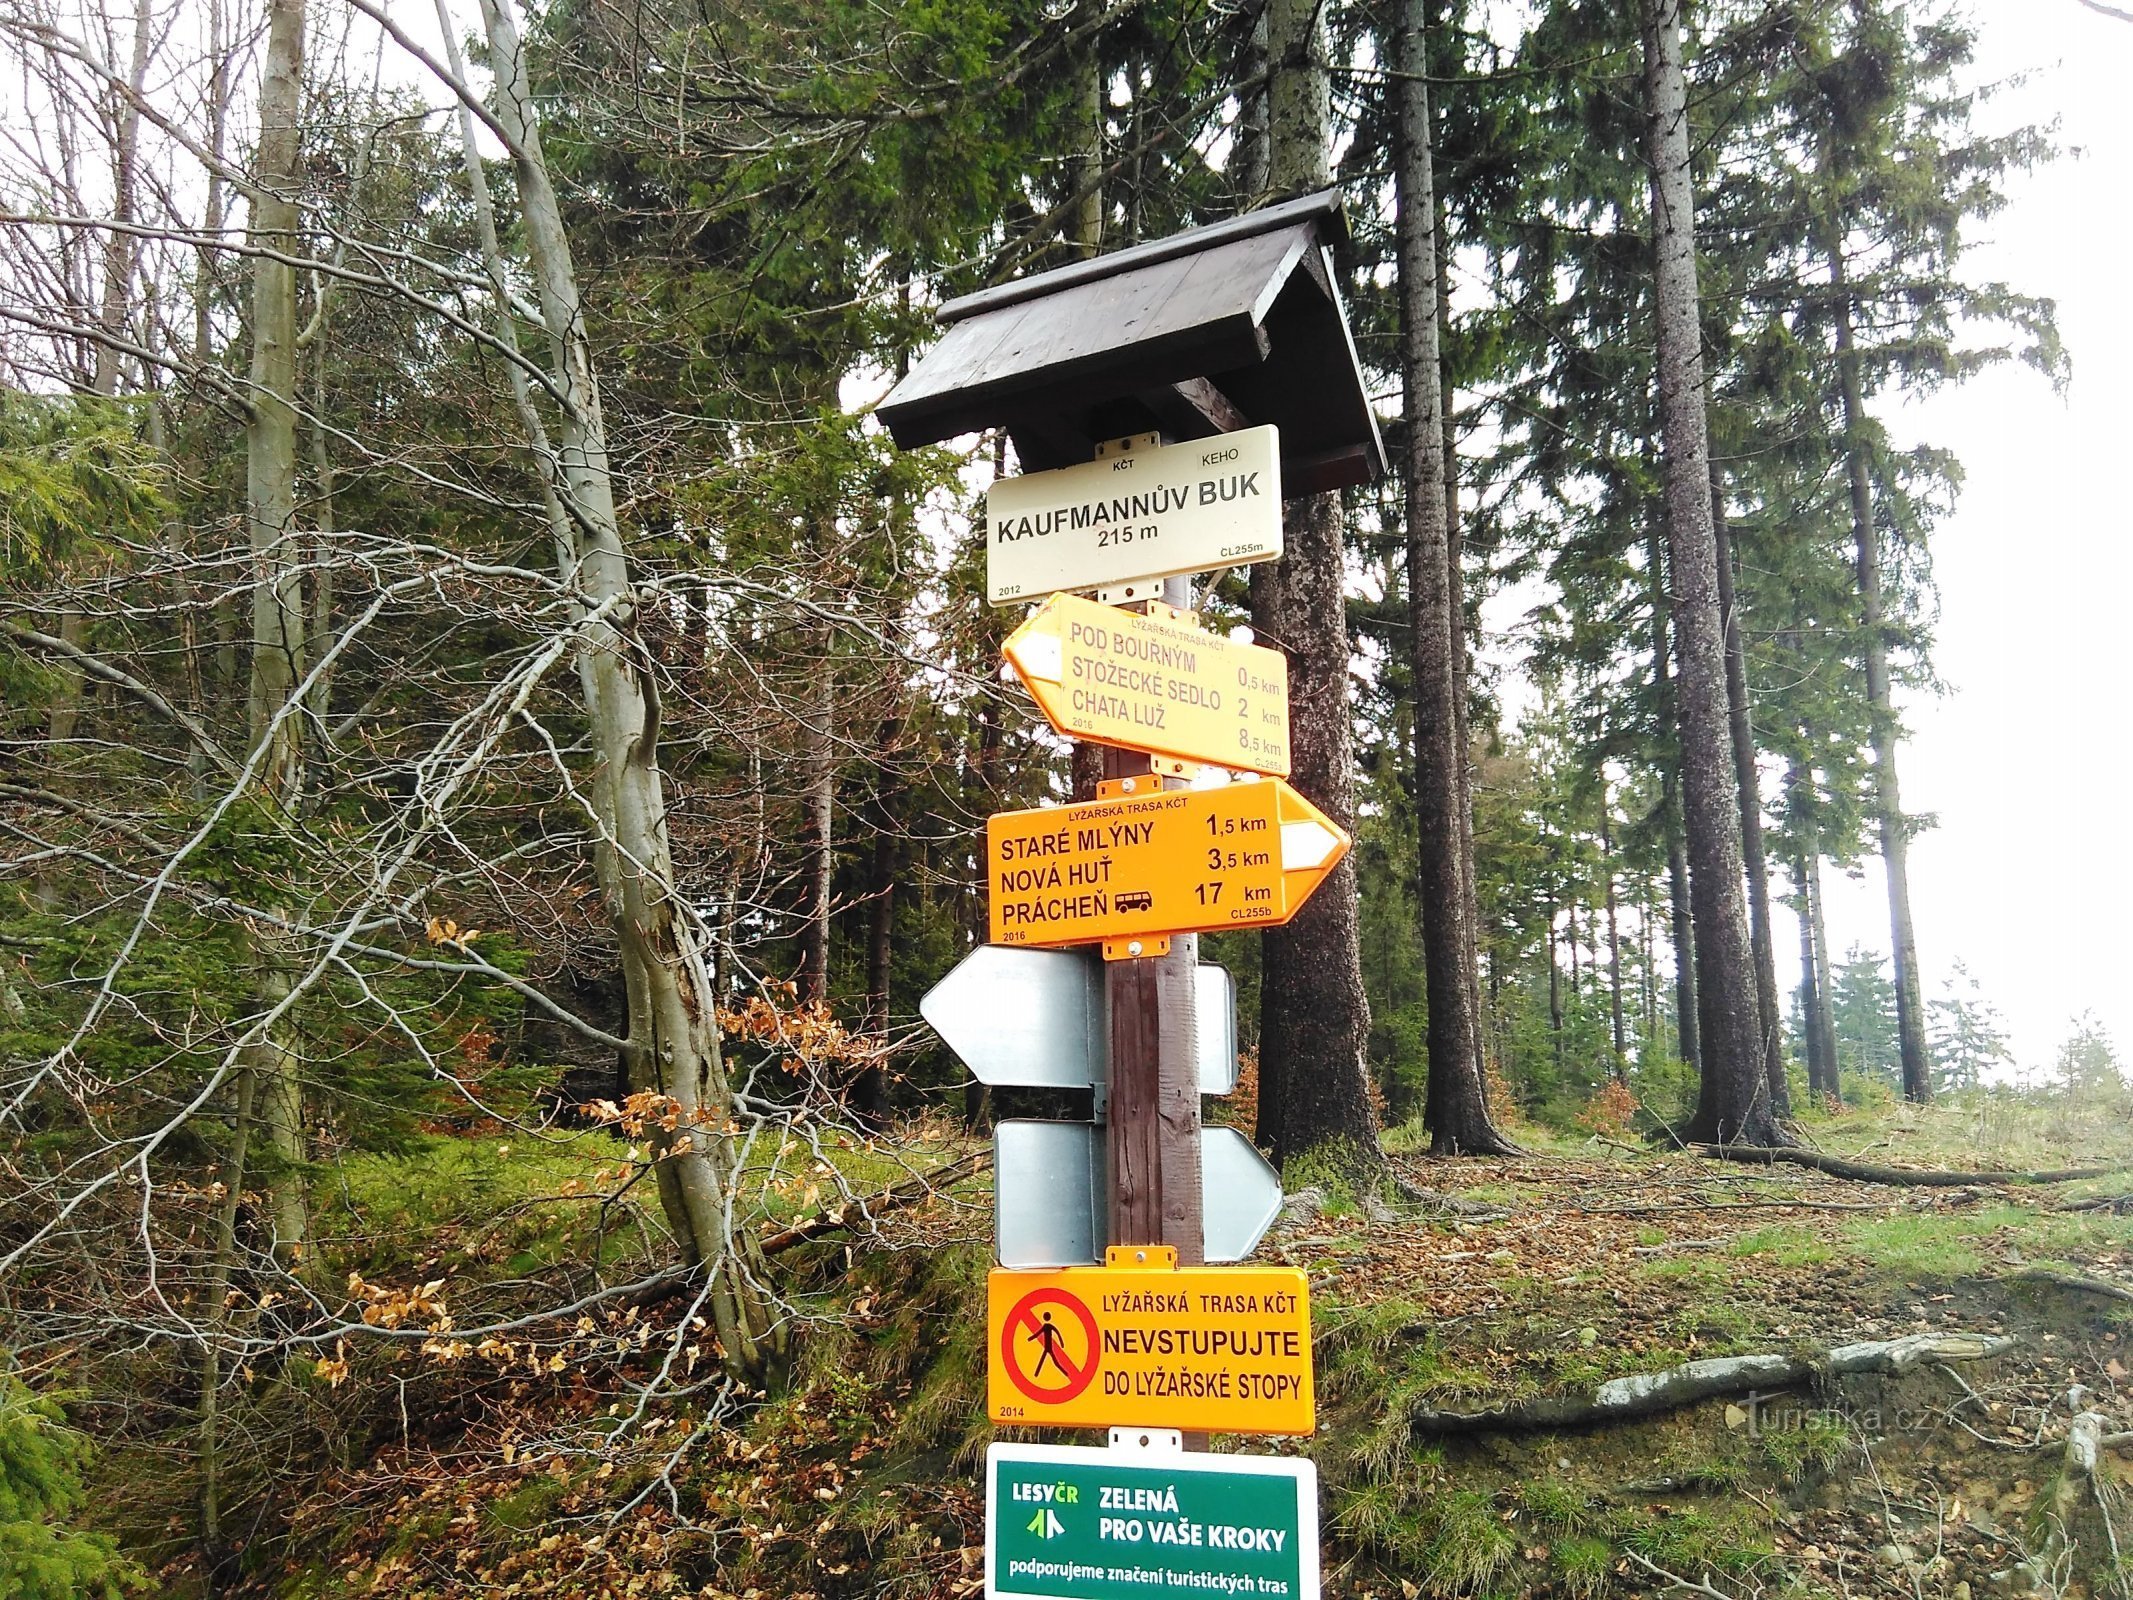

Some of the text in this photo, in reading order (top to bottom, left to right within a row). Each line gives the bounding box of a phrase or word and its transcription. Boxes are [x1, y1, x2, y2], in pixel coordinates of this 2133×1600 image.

[1113, 459, 1134, 471] KČT
[1202, 448, 1239, 467] KEHO
[998, 472, 1260, 543] KAUFMANNŮV BUK
[1098, 524, 1158, 548] 215 m
[1220, 543, 1263, 558] CL255m
[999, 585, 1021, 596] 2012
[1071, 621, 1196, 674] POD BOUŘNÝM
[1072, 656, 1221, 711] STOŽECKÉ SEDLO
[1261, 679, 1280, 696] km
[1072, 689, 1165, 730] CHATA LUŽ
[1238, 698, 1281, 726] 2 km
[1239, 728, 1282, 756] 8,5 km
[1068, 797, 1187, 822] LYŽAŘSKÁ TRASA KČT
[1206, 813, 1267, 838] 1,5 km
[1001, 821, 1155, 861] STARÉ MLÝNY
[1208, 848, 1269, 872] 3,5 km
[1001, 855, 1113, 893] NOVÁ HUŤ
[1194, 881, 1271, 906] 17 km
[1002, 889, 1108, 926] PRÁCHEŇ
[1230, 908, 1272, 920] CL255b
[1003, 931, 1026, 942] 2016
[1103, 1291, 1297, 1314] LYŽAŘSKÁ TRASA KČT
[1104, 1329, 1300, 1357] NEVSTUPUJTE
[1104, 1366, 1302, 1400] DO LYŽAŘSKÉ STOPY
[1000, 1406, 1024, 1418] 2014
[1099, 1484, 1179, 1514] ZELENÁ
[1099, 1517, 1286, 1552] PRO VAŠE KROKY
[1009, 1557, 1288, 1594] podporujeme značení turistických tras
